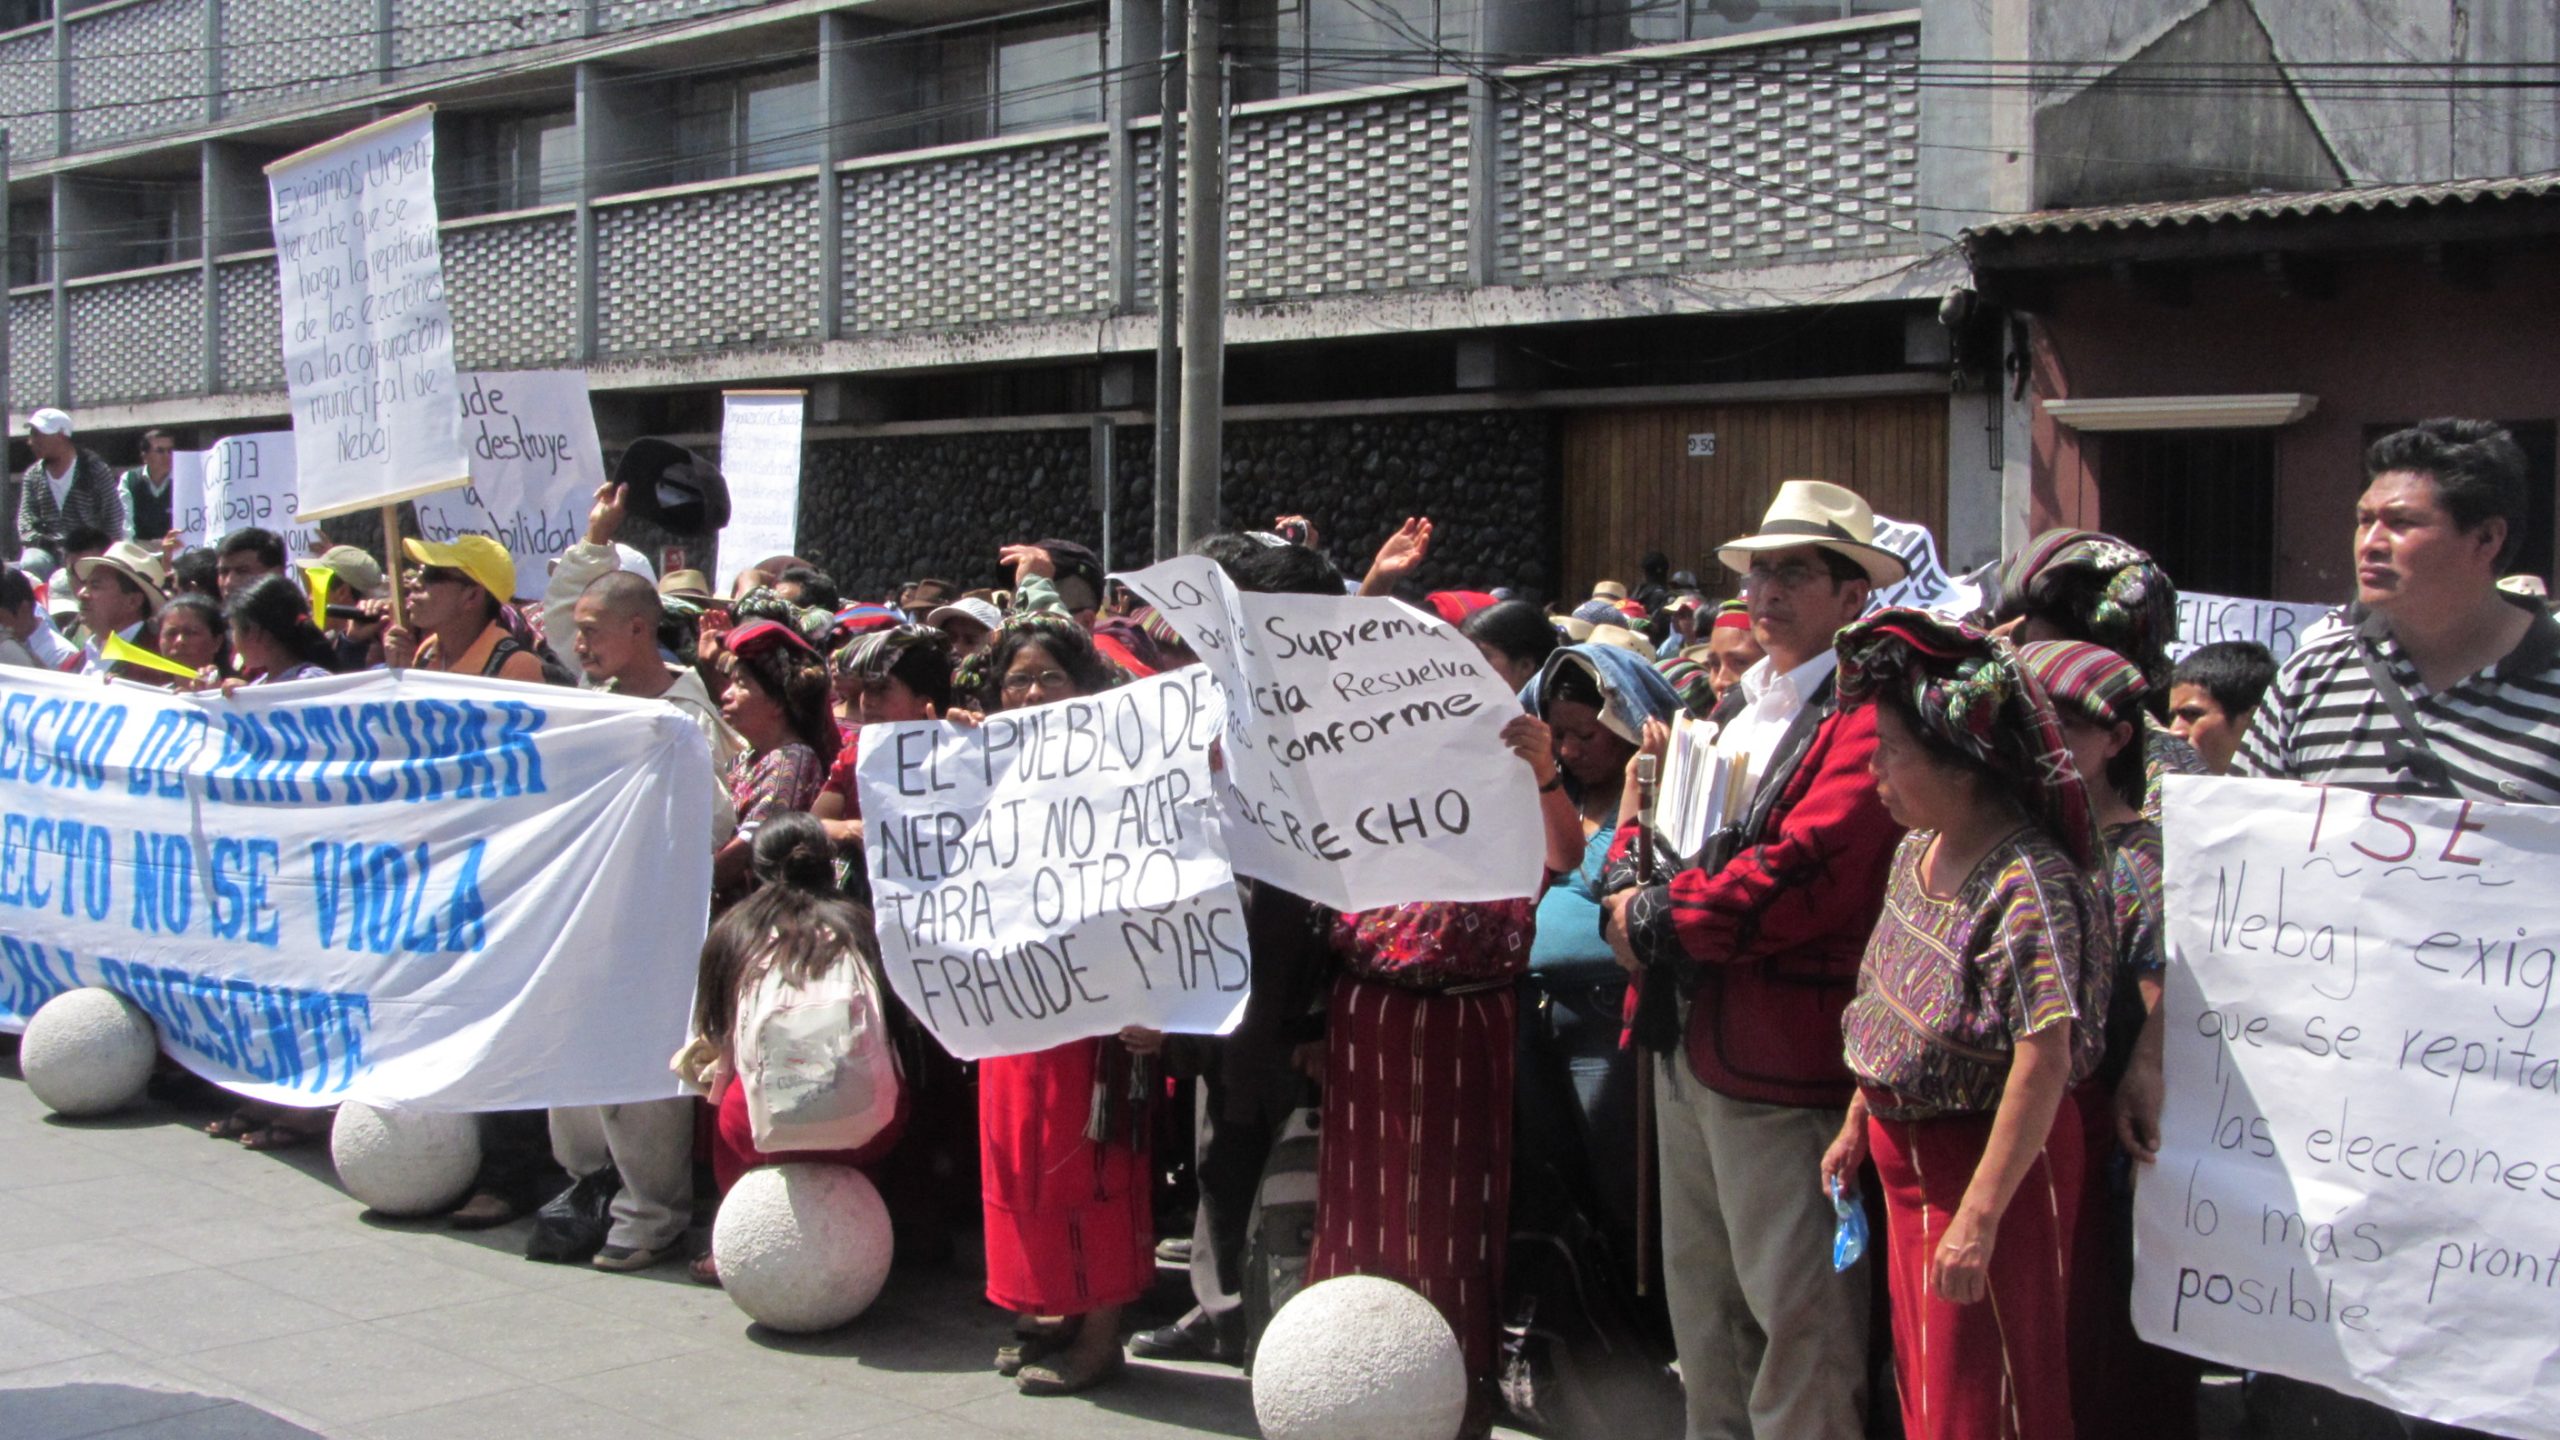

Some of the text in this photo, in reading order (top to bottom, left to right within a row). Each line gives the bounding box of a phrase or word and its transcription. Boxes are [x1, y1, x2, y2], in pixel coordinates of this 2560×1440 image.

[277, 160, 364, 223] Exigimos
[353, 207, 379, 240] que
[386, 198, 408, 226] se
[298, 262, 341, 299] haga
[349, 247, 369, 285] la
[295, 301, 317, 342] de
[329, 291, 354, 334] las
[300, 360, 314, 386] a
[323, 335, 341, 380] la
[310, 354, 438, 425] municipal de
[337, 413, 391, 464] Nebaj
[475, 415, 572, 476] destruye
[1265, 616, 1449, 660] Suprema
[1332, 658, 1486, 702] Resuelva
[128, 708, 209, 798] DE
[896, 671, 1208, 797] EL PUEBLO DE
[1269, 770, 1290, 799] A
[880, 798, 1027, 882] NEBAJ
[1042, 795, 1096, 859] NO
[1228, 783, 1470, 862] DERECHO
[0, 813, 488, 954] ECTO NO SE VIOLA
[885, 848, 1180, 953] TARA OTRO
[2209, 859, 2557, 1029] Nebaj exig
[912, 934, 1109, 1032] FRAUDE
[2196, 1009, 2269, 1084] que
[2300, 1015, 2361, 1060] se
[2210, 1071, 2560, 1201] las elecciones
[2185, 1158, 2219, 1236] lo
[2263, 1202, 2383, 1262] más
